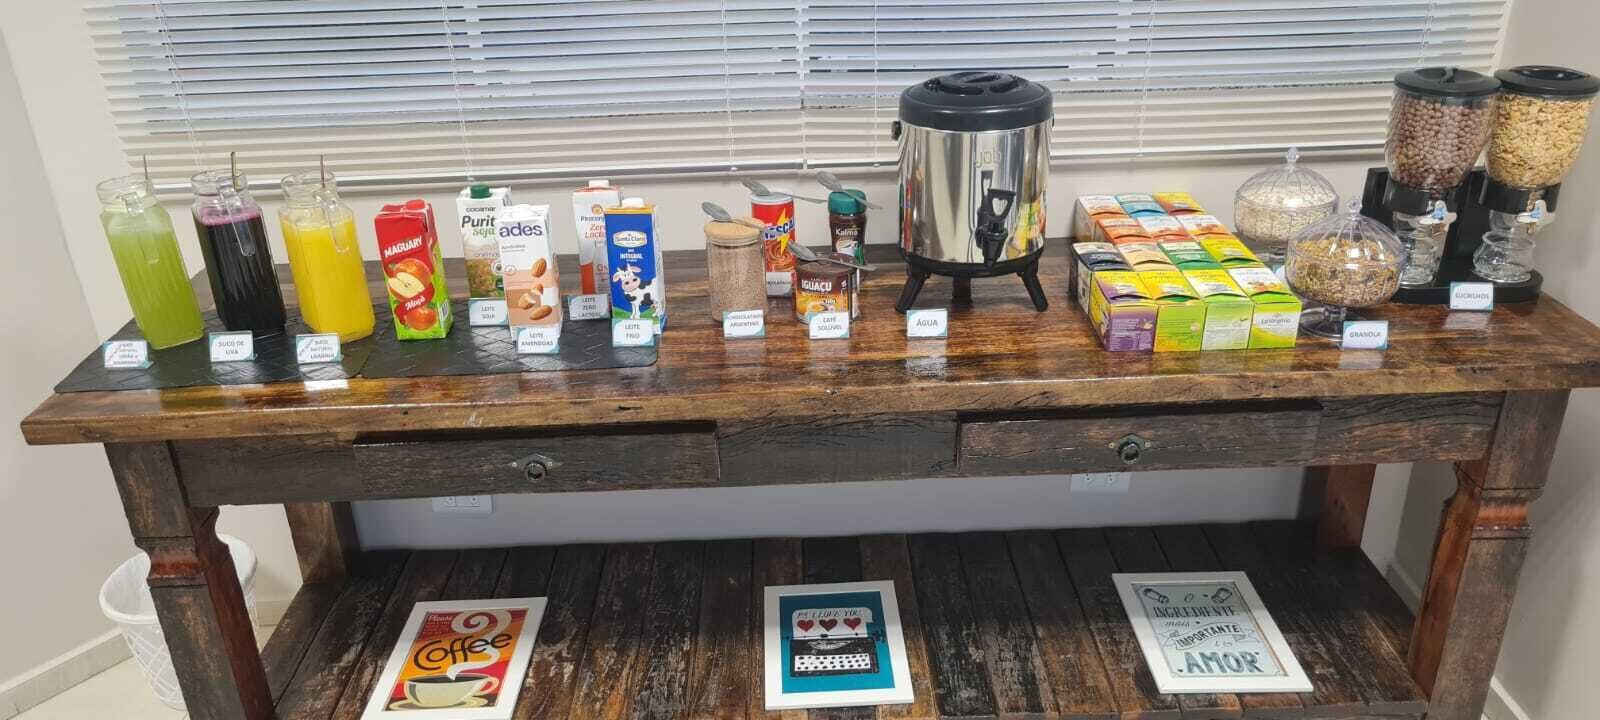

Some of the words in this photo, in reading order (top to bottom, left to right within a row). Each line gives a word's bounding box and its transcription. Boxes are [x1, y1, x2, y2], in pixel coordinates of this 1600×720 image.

[461, 215, 497, 228] Purit
[499, 222, 544, 238] ades
[384, 236, 422, 258] MAGUARY
[801, 280, 832, 293] IGUAÇU
[916, 318, 939, 327] ÁGUA
[1152, 606, 1237, 618] INGREDIENTE
[1175, 624, 1240, 648] IMPORTANTE
[413, 633, 513, 671] Coffee
[1184, 651, 1264, 673] AMOR
